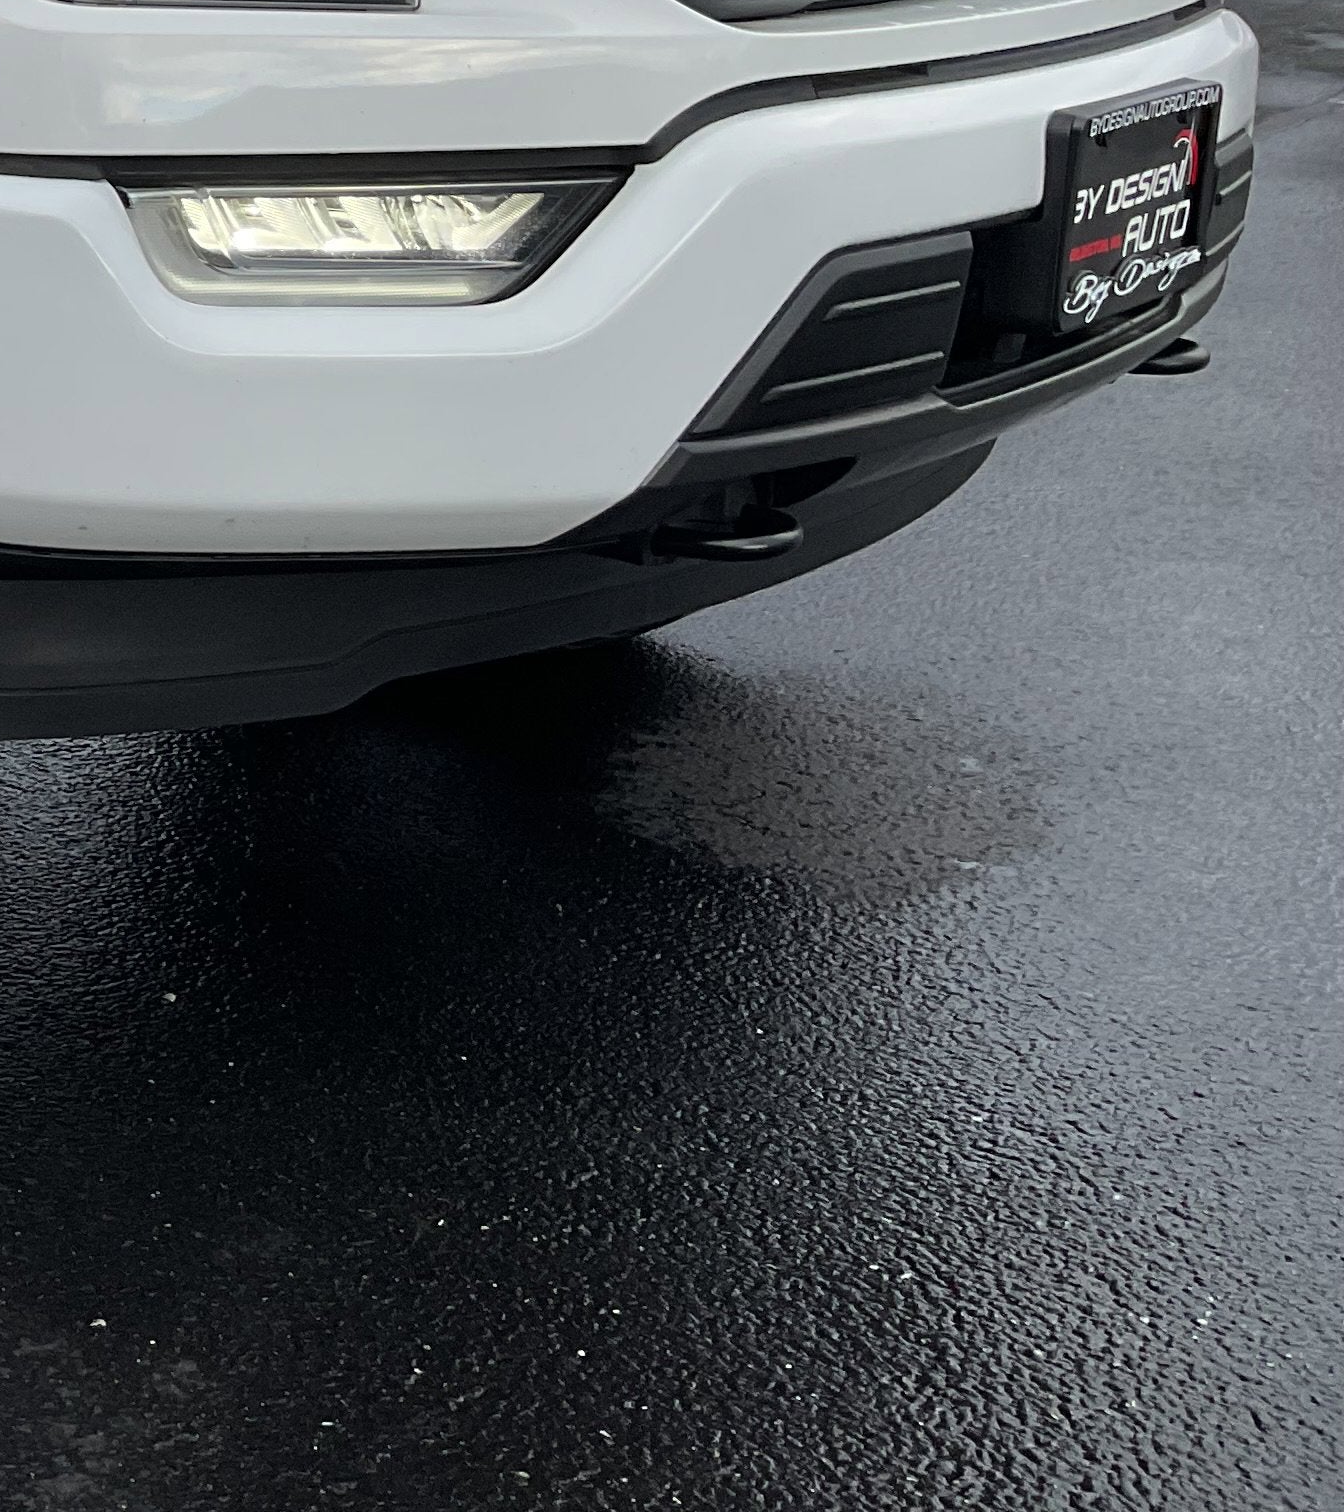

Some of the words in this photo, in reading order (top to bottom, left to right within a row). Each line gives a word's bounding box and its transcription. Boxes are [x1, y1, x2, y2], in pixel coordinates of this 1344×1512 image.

[1090, 87, 1221, 138] BYDESIGNAUTOGROUP.COM
[1105, 159, 1186, 215] DESIGN
[1122, 199, 1191, 257] AUTO
[1063, 271, 1113, 323] By
[1113, 247, 1201, 296] Design
